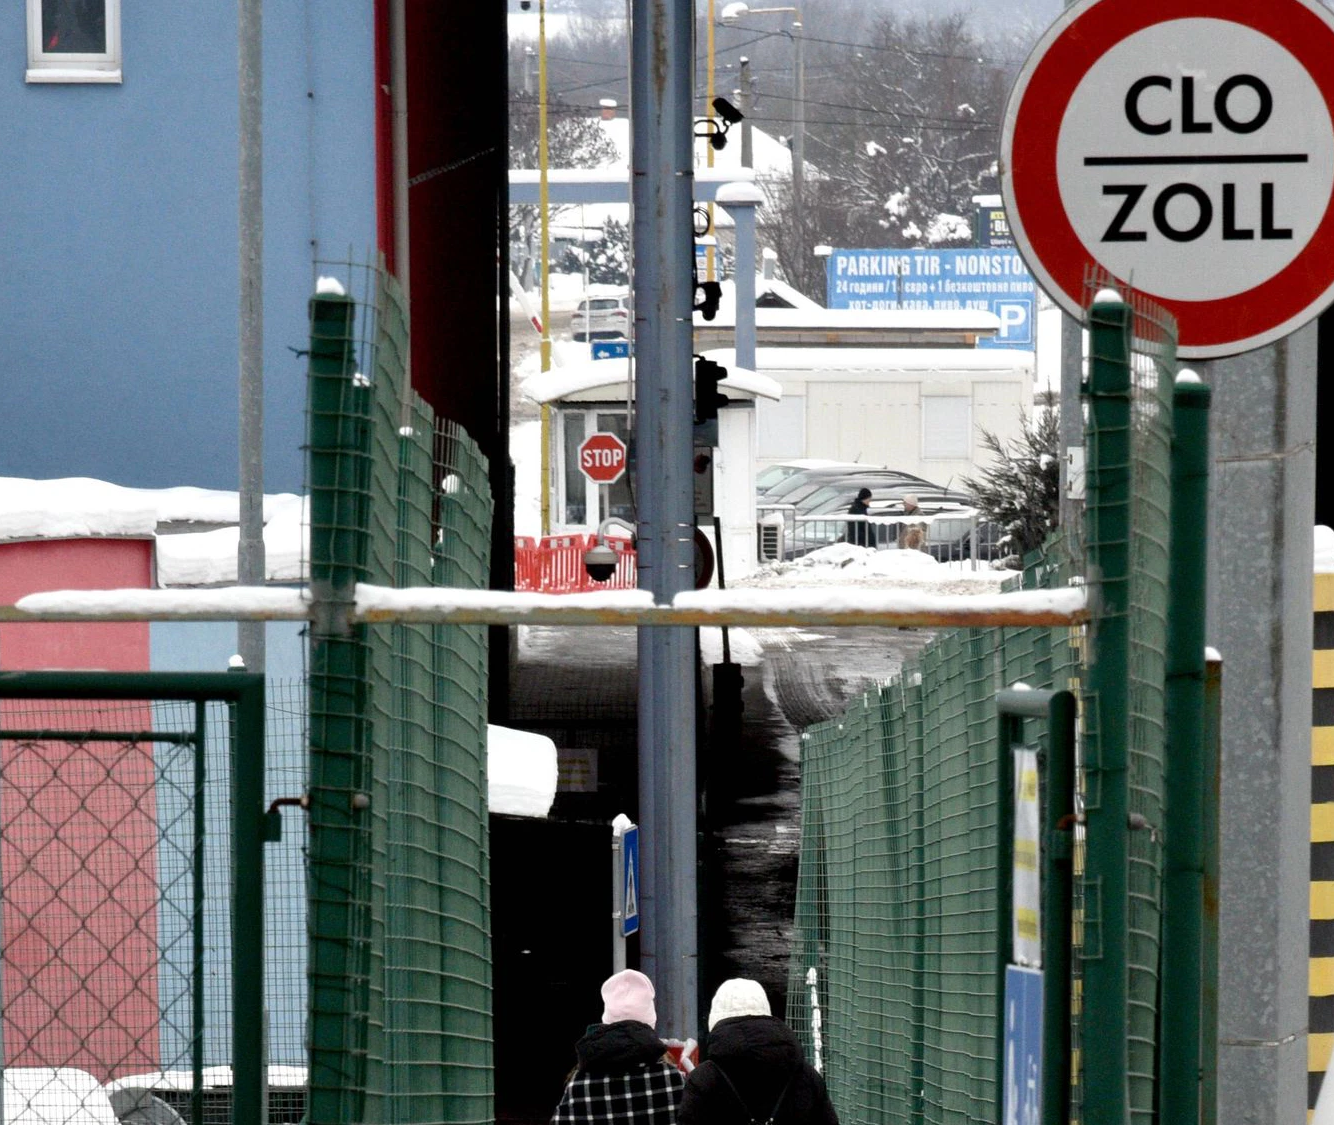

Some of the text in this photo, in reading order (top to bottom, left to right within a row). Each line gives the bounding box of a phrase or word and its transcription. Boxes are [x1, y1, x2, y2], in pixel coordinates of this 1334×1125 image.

[1124, 74, 1273, 136] CLO
[1100, 182, 1294, 243] ZOLL
[836, 255, 911, 276] PARKING
[914, 255, 941, 276] TIR
[955, 254, 1030, 276] NONSTO
[836, 280, 848, 293] 24
[849, 282, 885, 295] години
[944, 279, 1009, 293] безкоштовне
[1009, 281, 1034, 293] пиво
[1000, 304, 1026, 338] P
[583, 449, 623, 468] STOP
